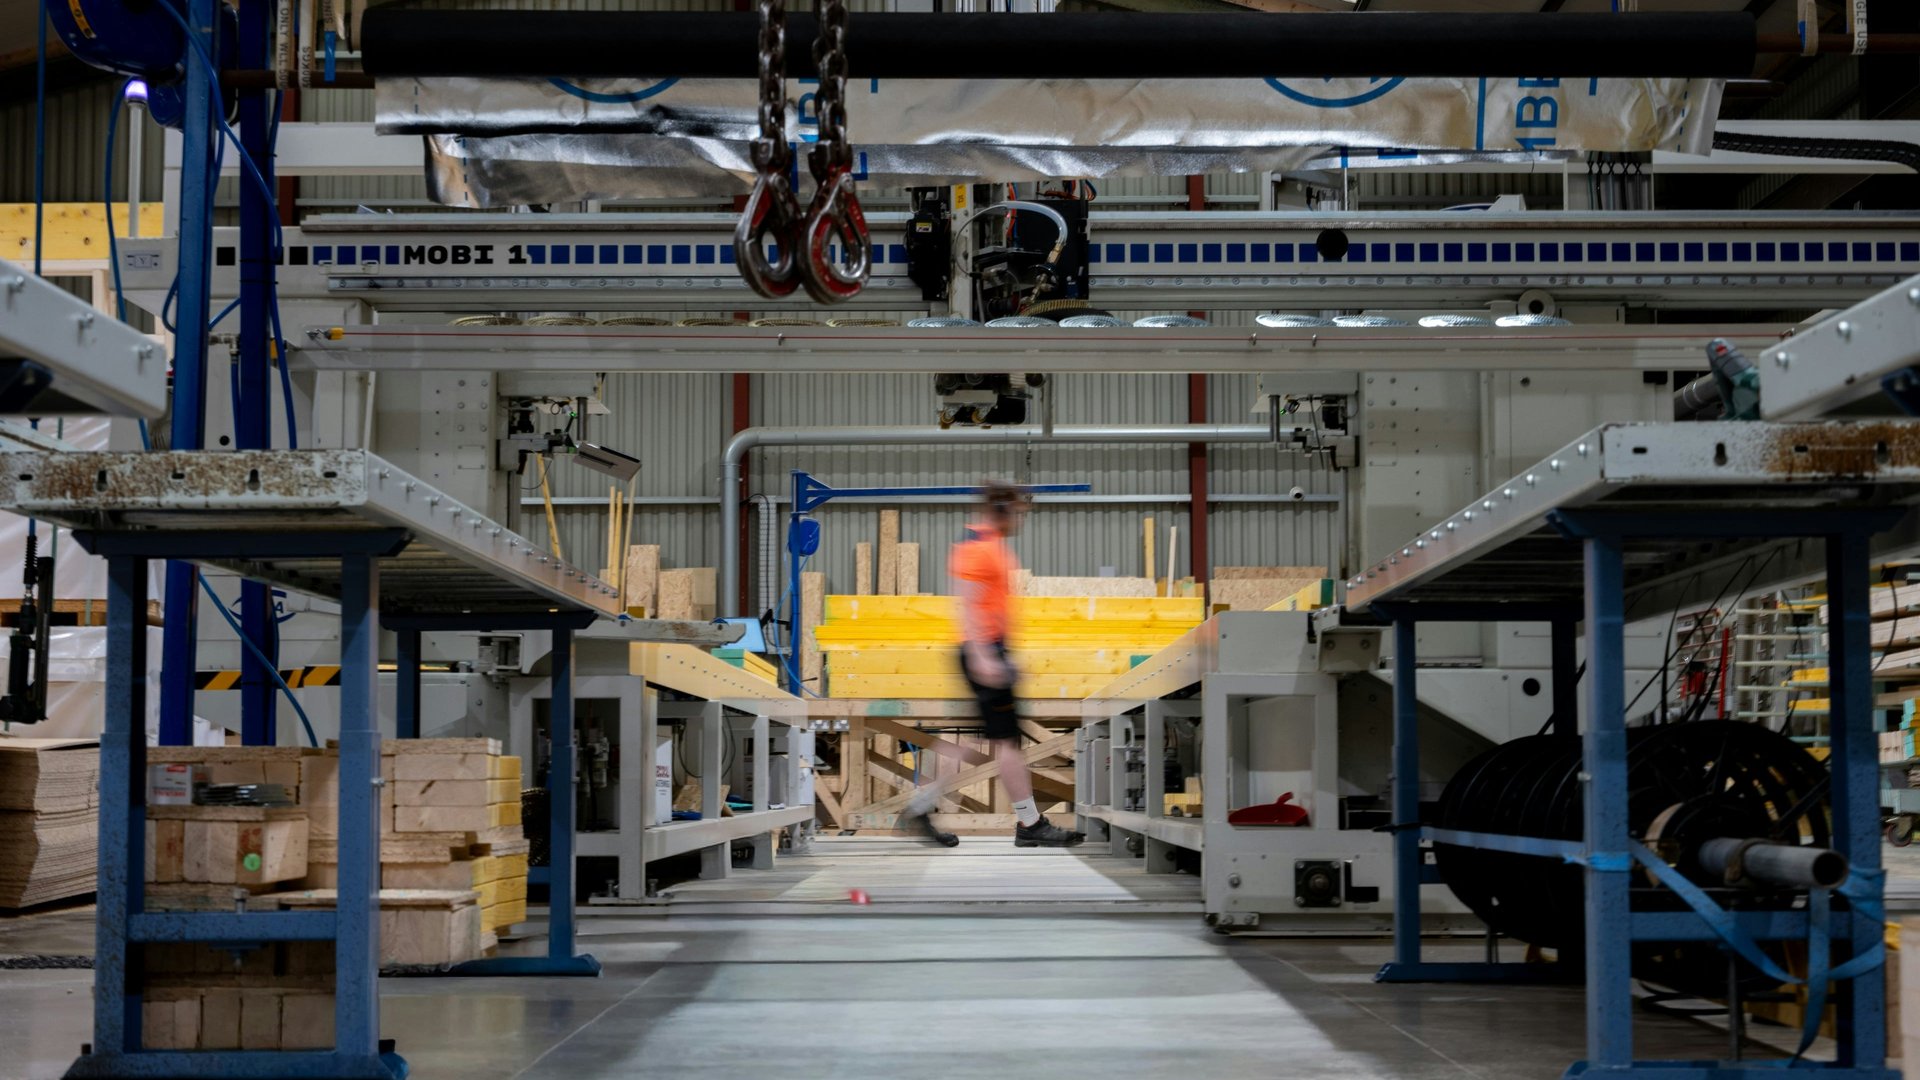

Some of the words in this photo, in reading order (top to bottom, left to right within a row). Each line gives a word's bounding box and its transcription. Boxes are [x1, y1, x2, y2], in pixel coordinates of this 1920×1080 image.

[279, 8, 289, 36] ONLY
[1856, 32, 1867, 53] USE
[404, 245, 494, 264] MOBI
[508, 245, 526, 264] 1
